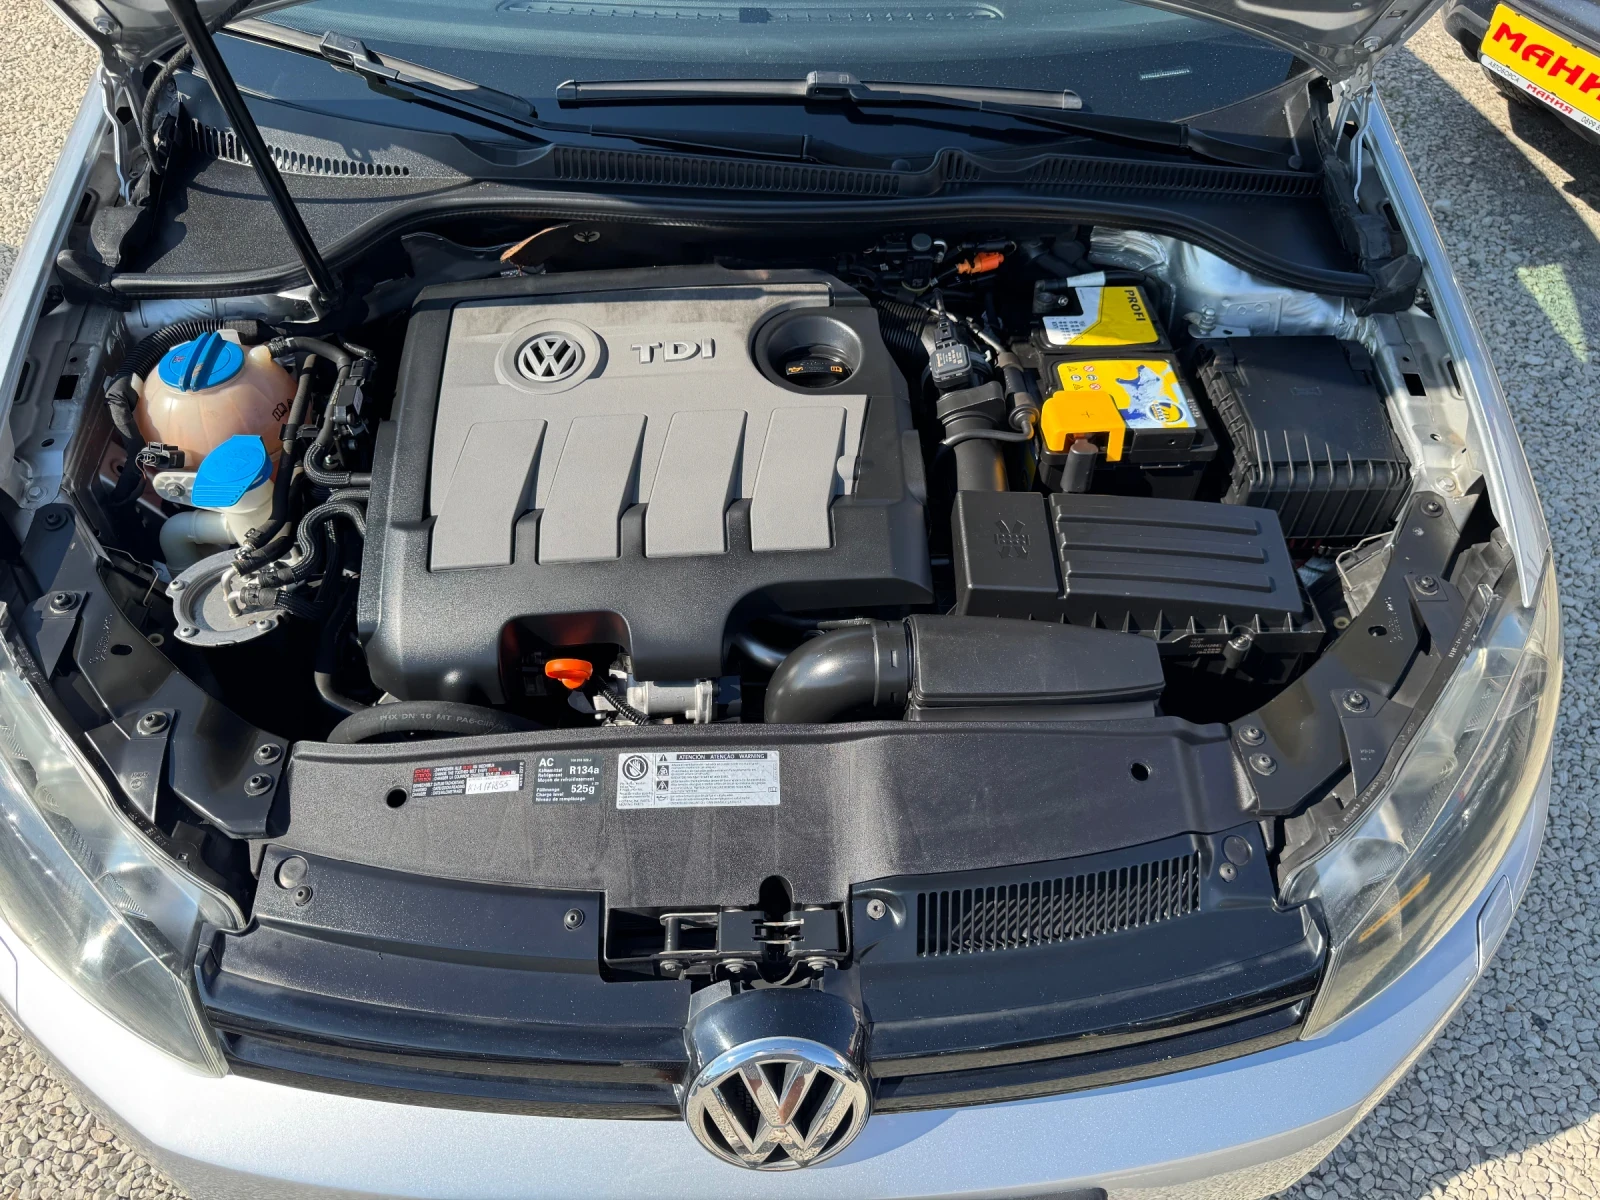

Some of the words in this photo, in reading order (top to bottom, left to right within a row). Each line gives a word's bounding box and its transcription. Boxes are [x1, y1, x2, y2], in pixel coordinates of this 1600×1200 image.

[1488, 61, 1520, 83] АВТОБОРСА
[1526, 83, 1574, 114] МАНИЯ
[1124, 290, 1146, 321] PROFI
[631, 338, 714, 364] TDI
[538, 757, 554, 767] AC
[570, 765, 600, 775] R134a
[571, 784, 595, 795] 525g
